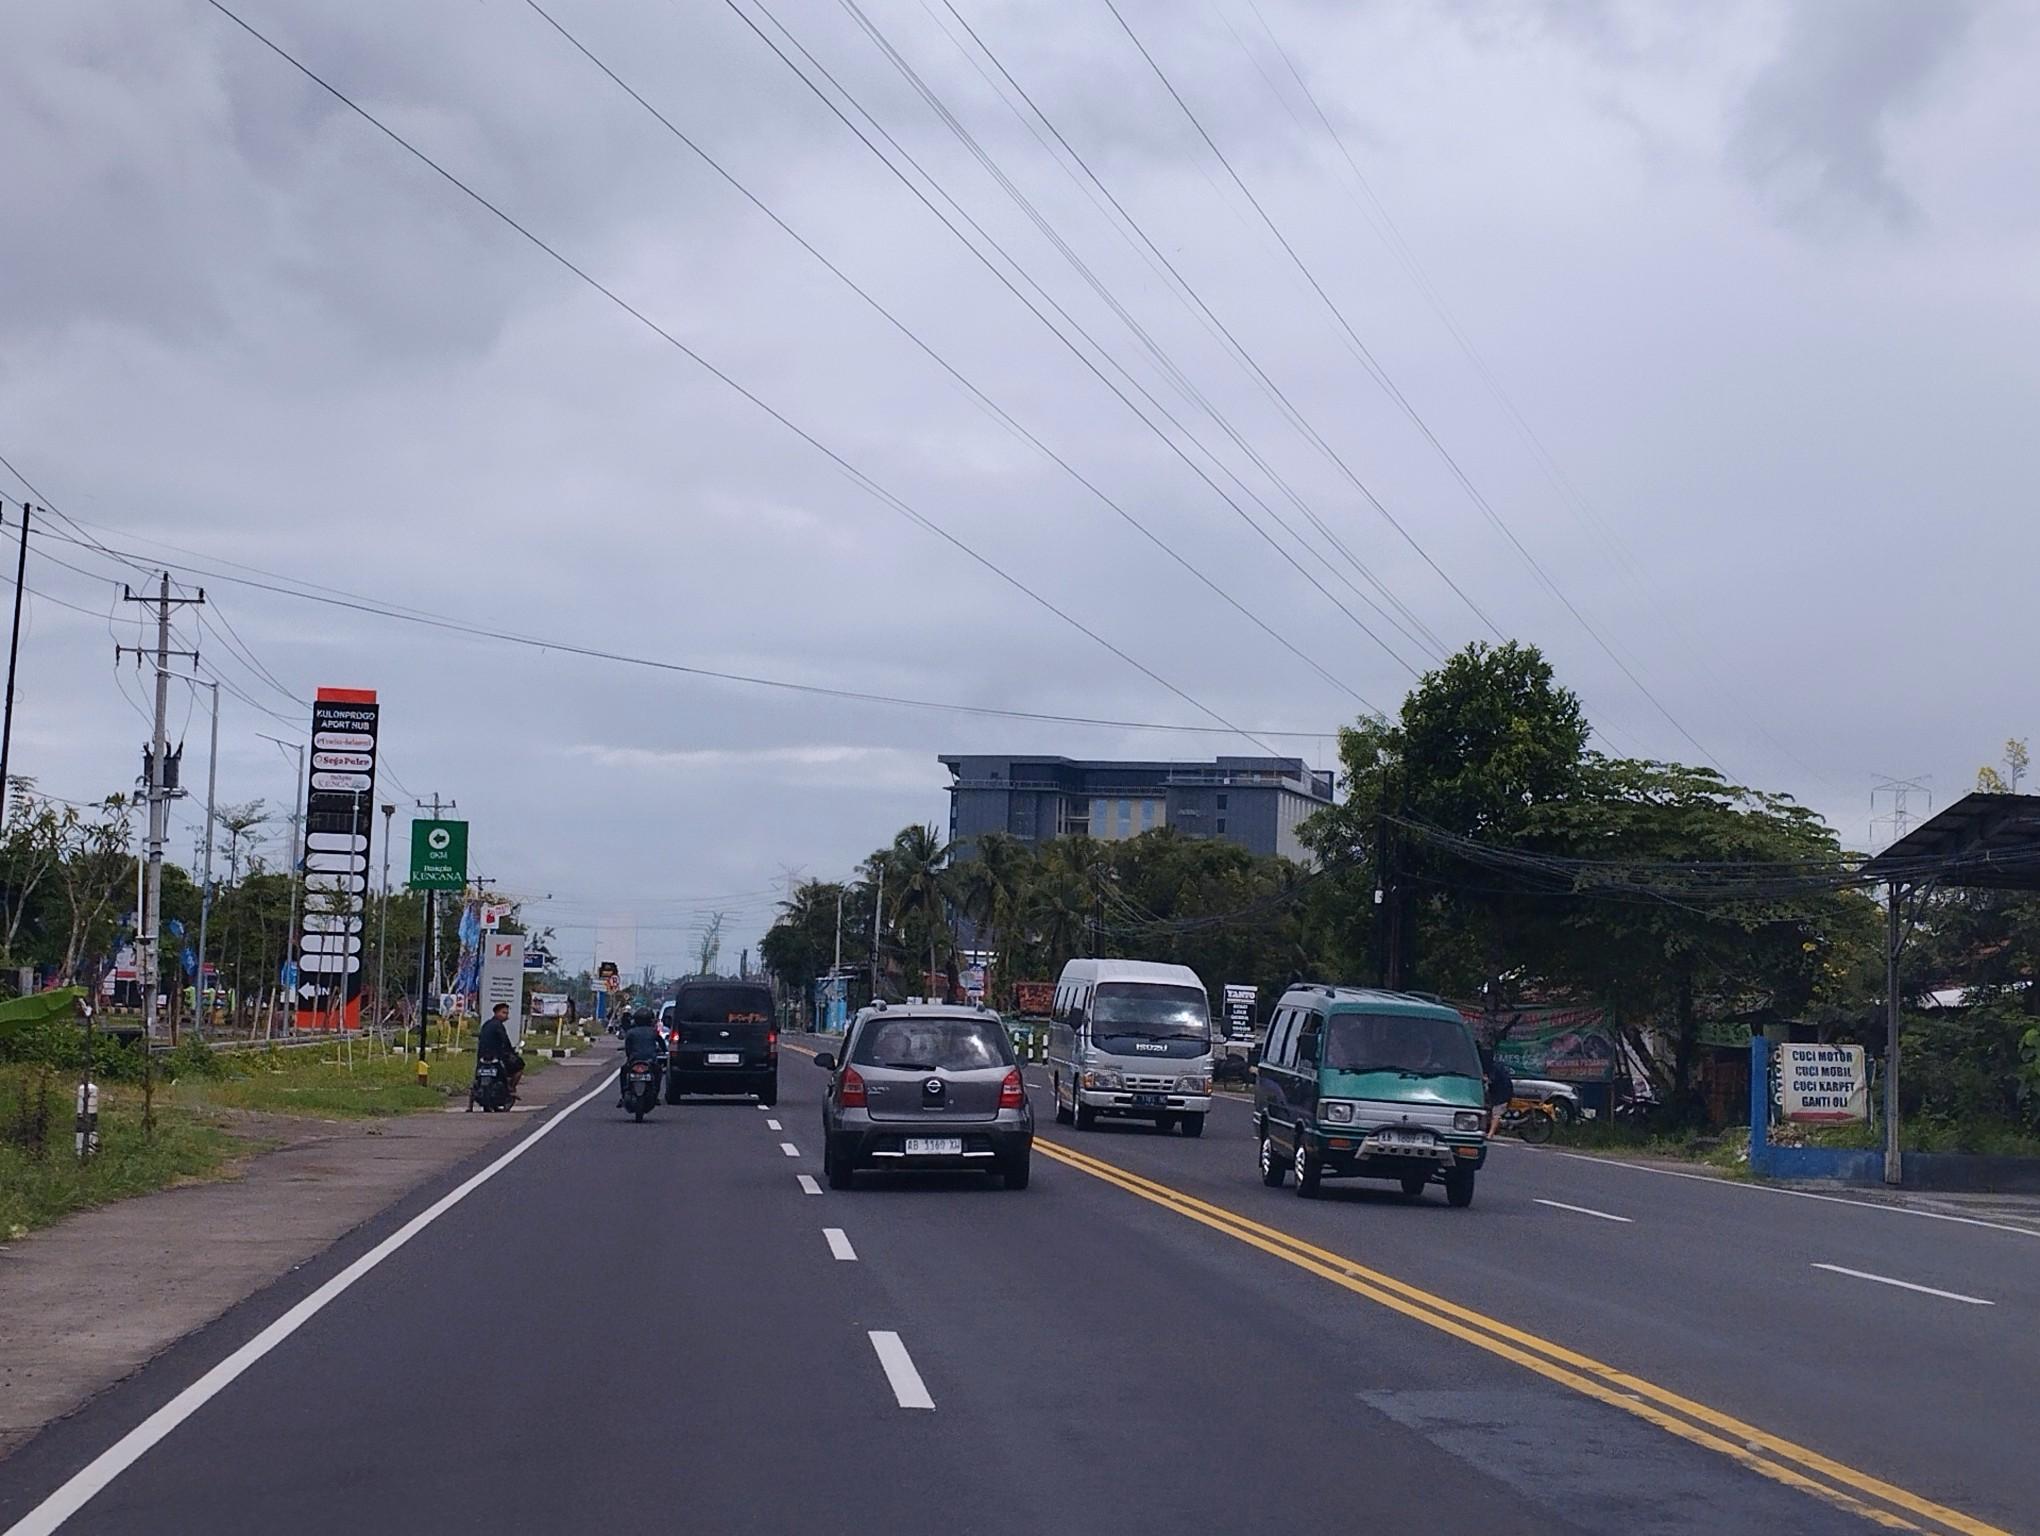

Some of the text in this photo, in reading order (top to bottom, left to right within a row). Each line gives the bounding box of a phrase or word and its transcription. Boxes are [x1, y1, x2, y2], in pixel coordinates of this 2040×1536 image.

[351, 721, 370, 730] HUB
[412, 871, 463, 881] KENCANA
[1135, 1043, 1168, 1052] ISUZU
[1792, 1050, 1853, 1062] CUCI MOTOR
[1795, 1066, 1852, 1077] CUCI MOBIL
[1793, 1080, 1855, 1092] CUCI KARPET
[1802, 1096, 1848, 1107] GANTI OLI
